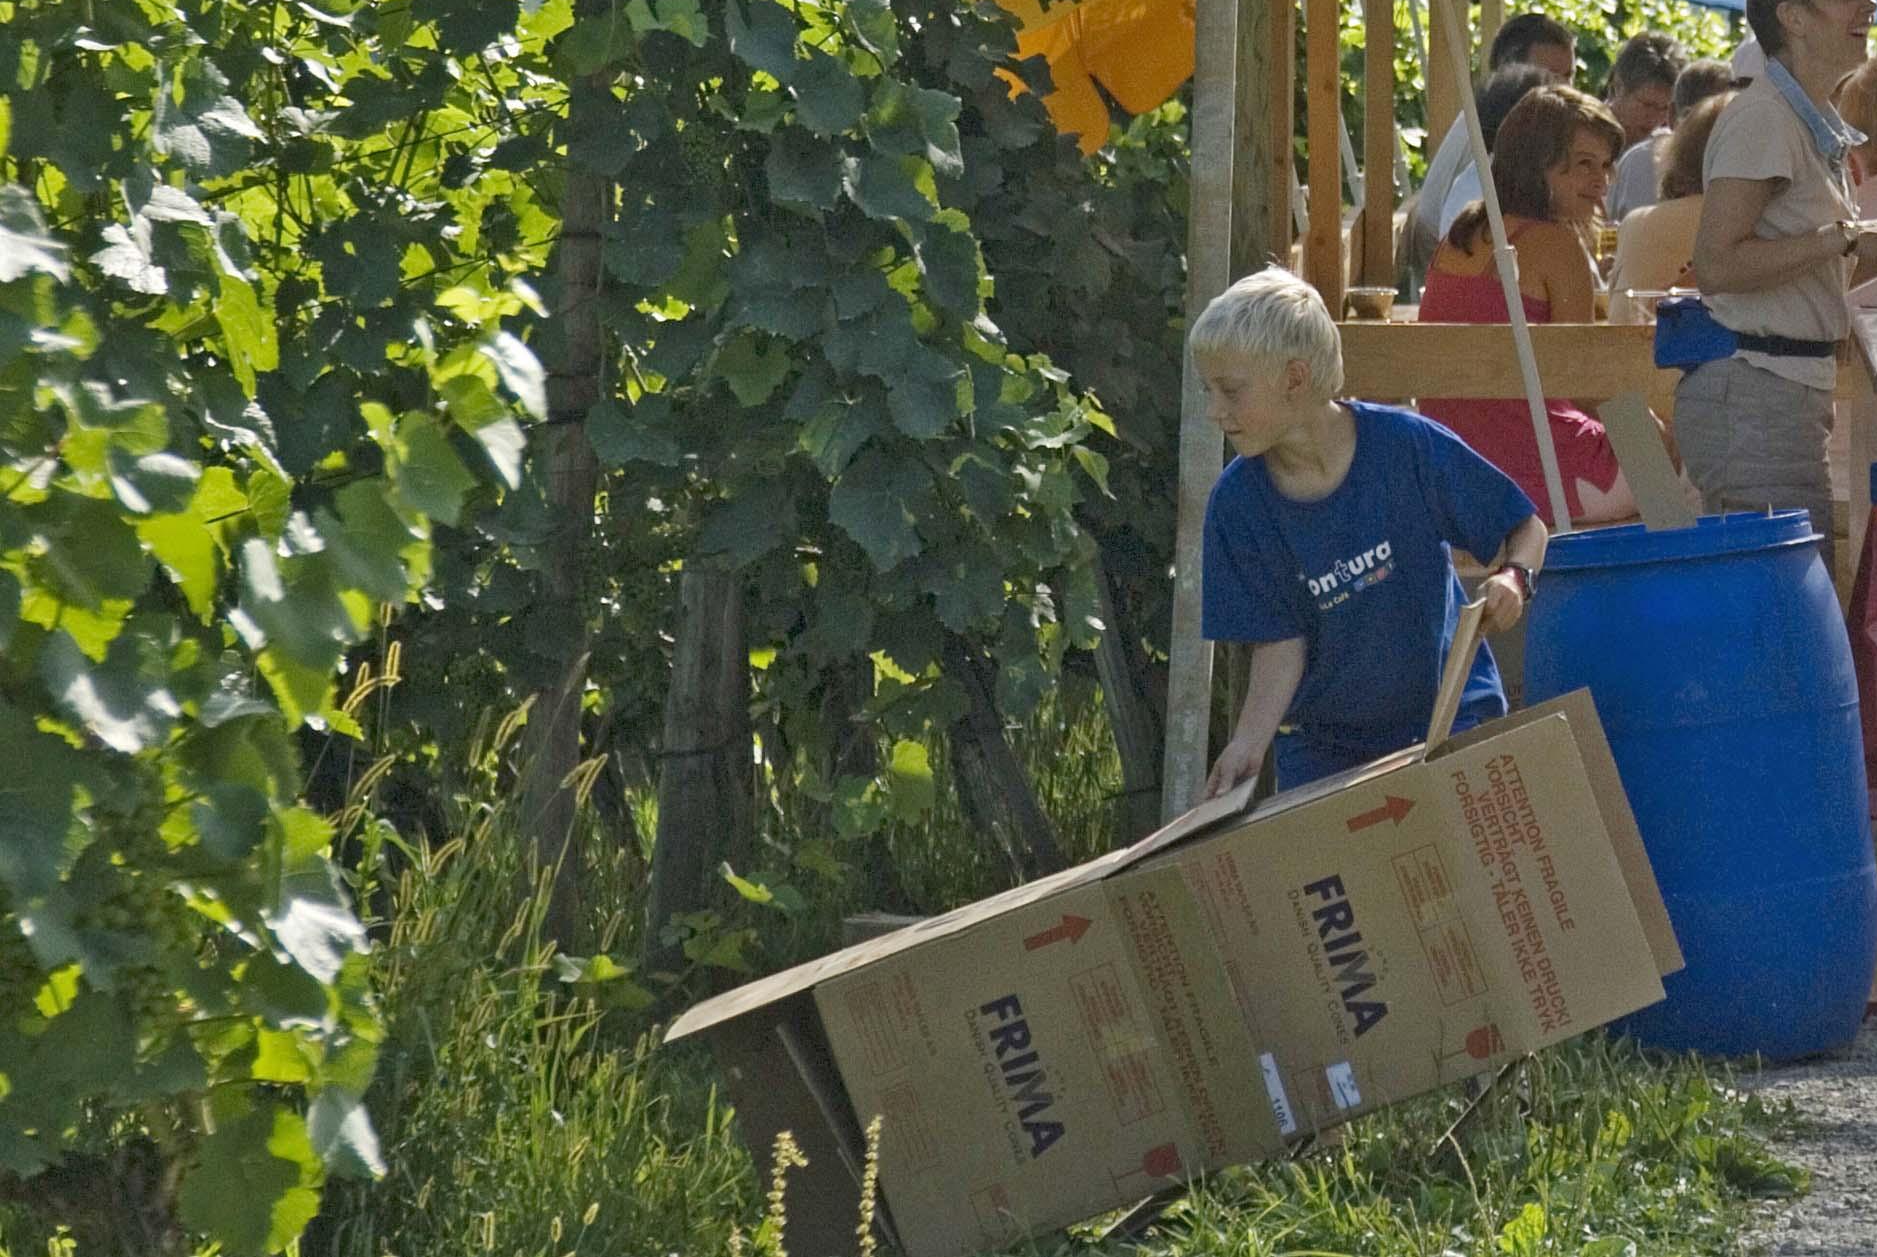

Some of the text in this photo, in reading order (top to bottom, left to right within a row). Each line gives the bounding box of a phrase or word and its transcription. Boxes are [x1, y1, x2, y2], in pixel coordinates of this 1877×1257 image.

[1482, 759, 1525, 846] VORSICHT
[1497, 753, 1574, 932] ATTENTION FRAGILE
[1302, 872, 1389, 1038] FRIMA
[1448, 771, 1495, 867] FORSIGTIG
[1510, 939, 1537, 982] IKKE
[1527, 984, 1556, 1035] TRYK
[1510, 889, 1543, 954] KEINEN
[978, 992, 1067, 1159] FRIMA
